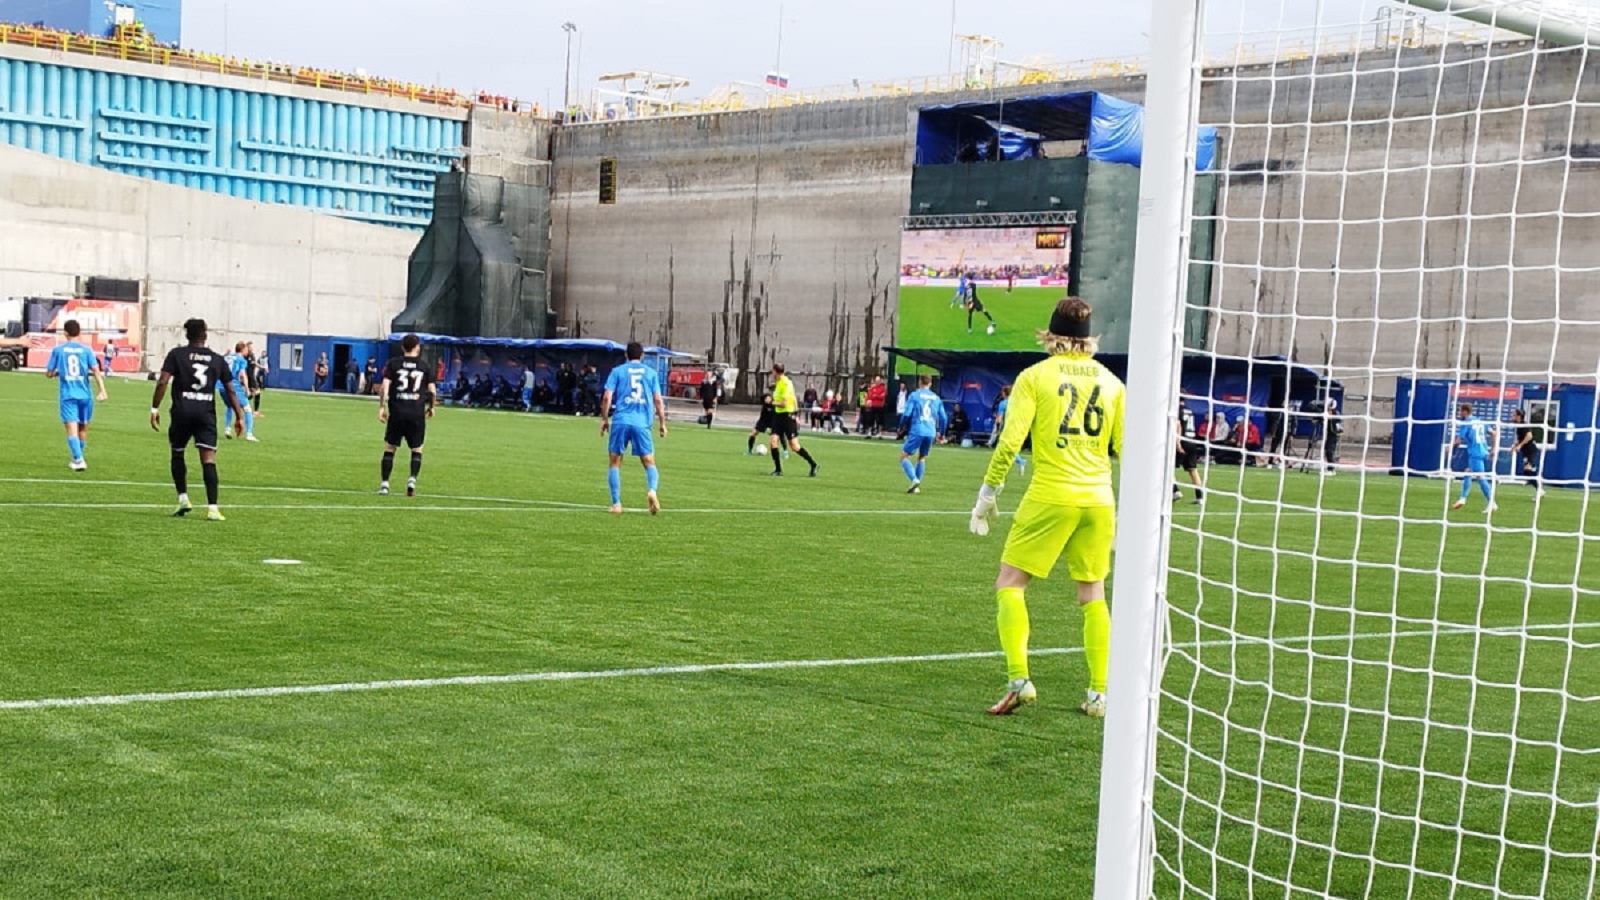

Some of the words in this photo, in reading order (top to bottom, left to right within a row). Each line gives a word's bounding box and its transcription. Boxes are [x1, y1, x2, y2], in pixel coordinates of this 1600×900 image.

[68, 354, 79, 377] 8
[191, 363, 209, 390] 3
[396, 368, 424, 392] 37
[631, 374, 642, 400] 5
[1058, 382, 1104, 437] 26
